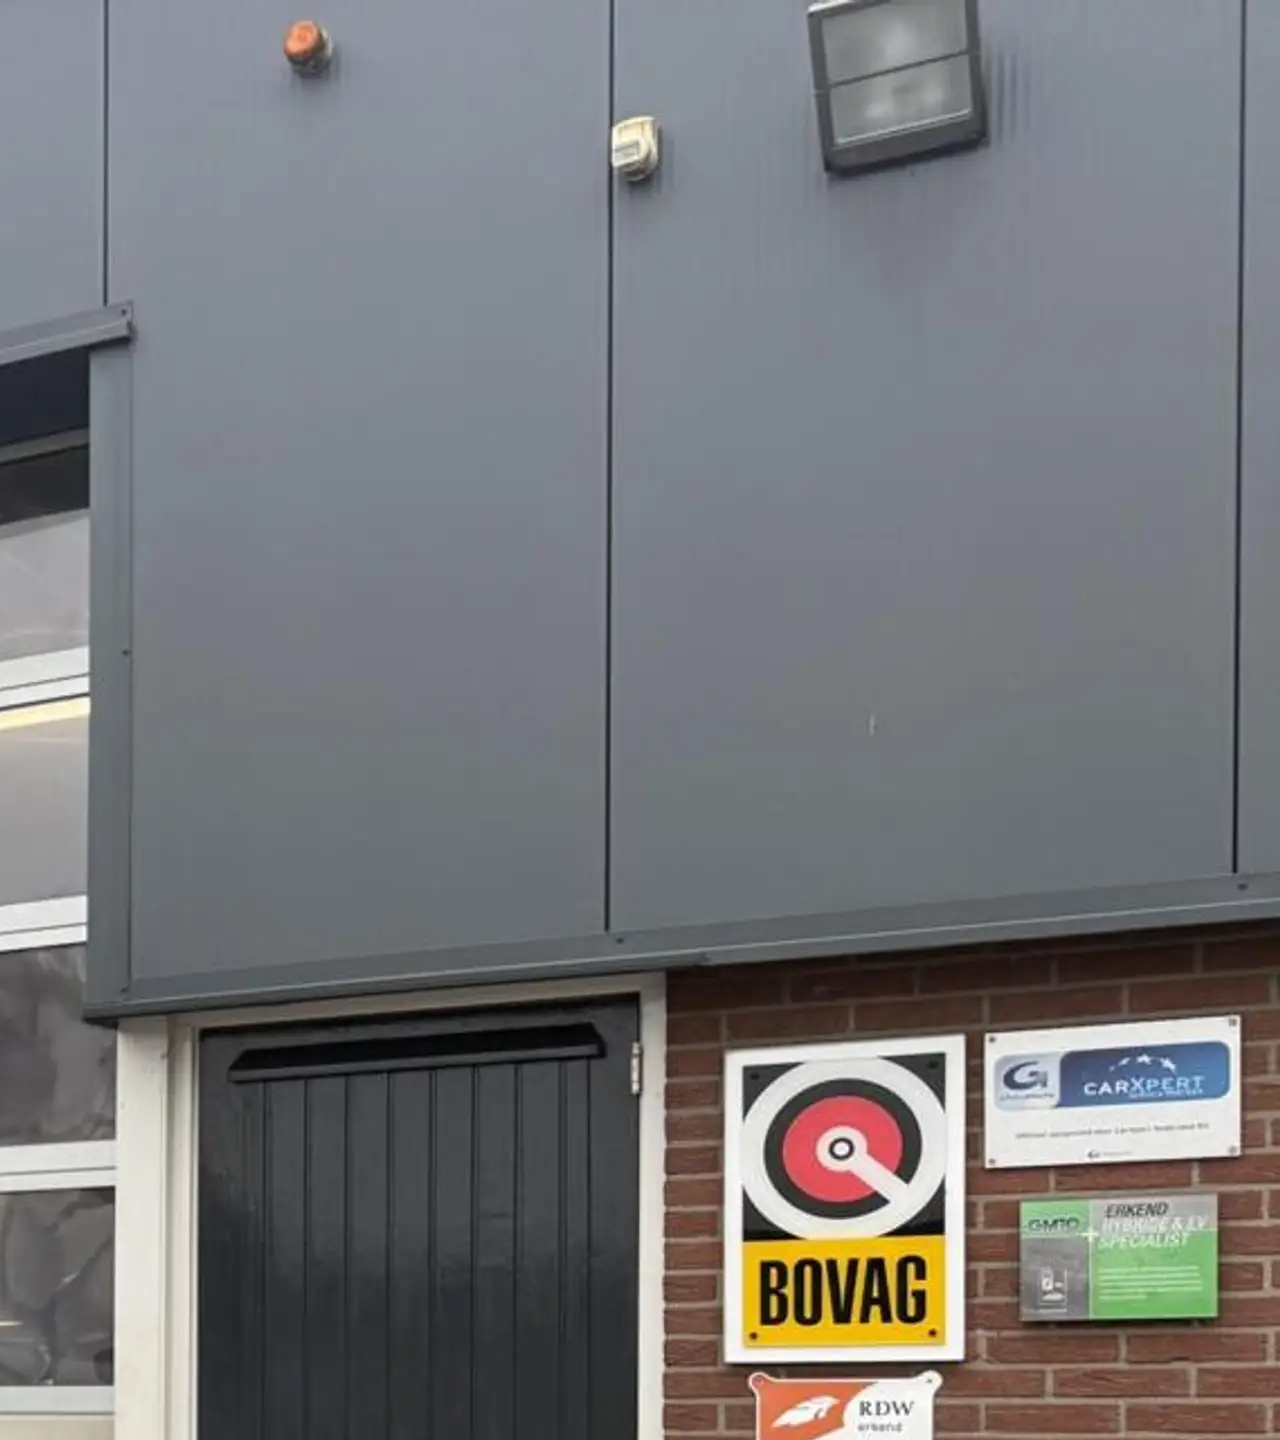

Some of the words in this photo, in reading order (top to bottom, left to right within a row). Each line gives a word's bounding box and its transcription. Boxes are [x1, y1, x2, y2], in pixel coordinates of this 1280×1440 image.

[1084, 1076, 1206, 1096] CARXPERT
[1103, 1202, 1169, 1218] ERKEND
[1097, 1232, 1190, 1250] SPECIALIST
[760, 1255, 927, 1326] BOVAG
[859, 1400, 915, 1416] RDW
